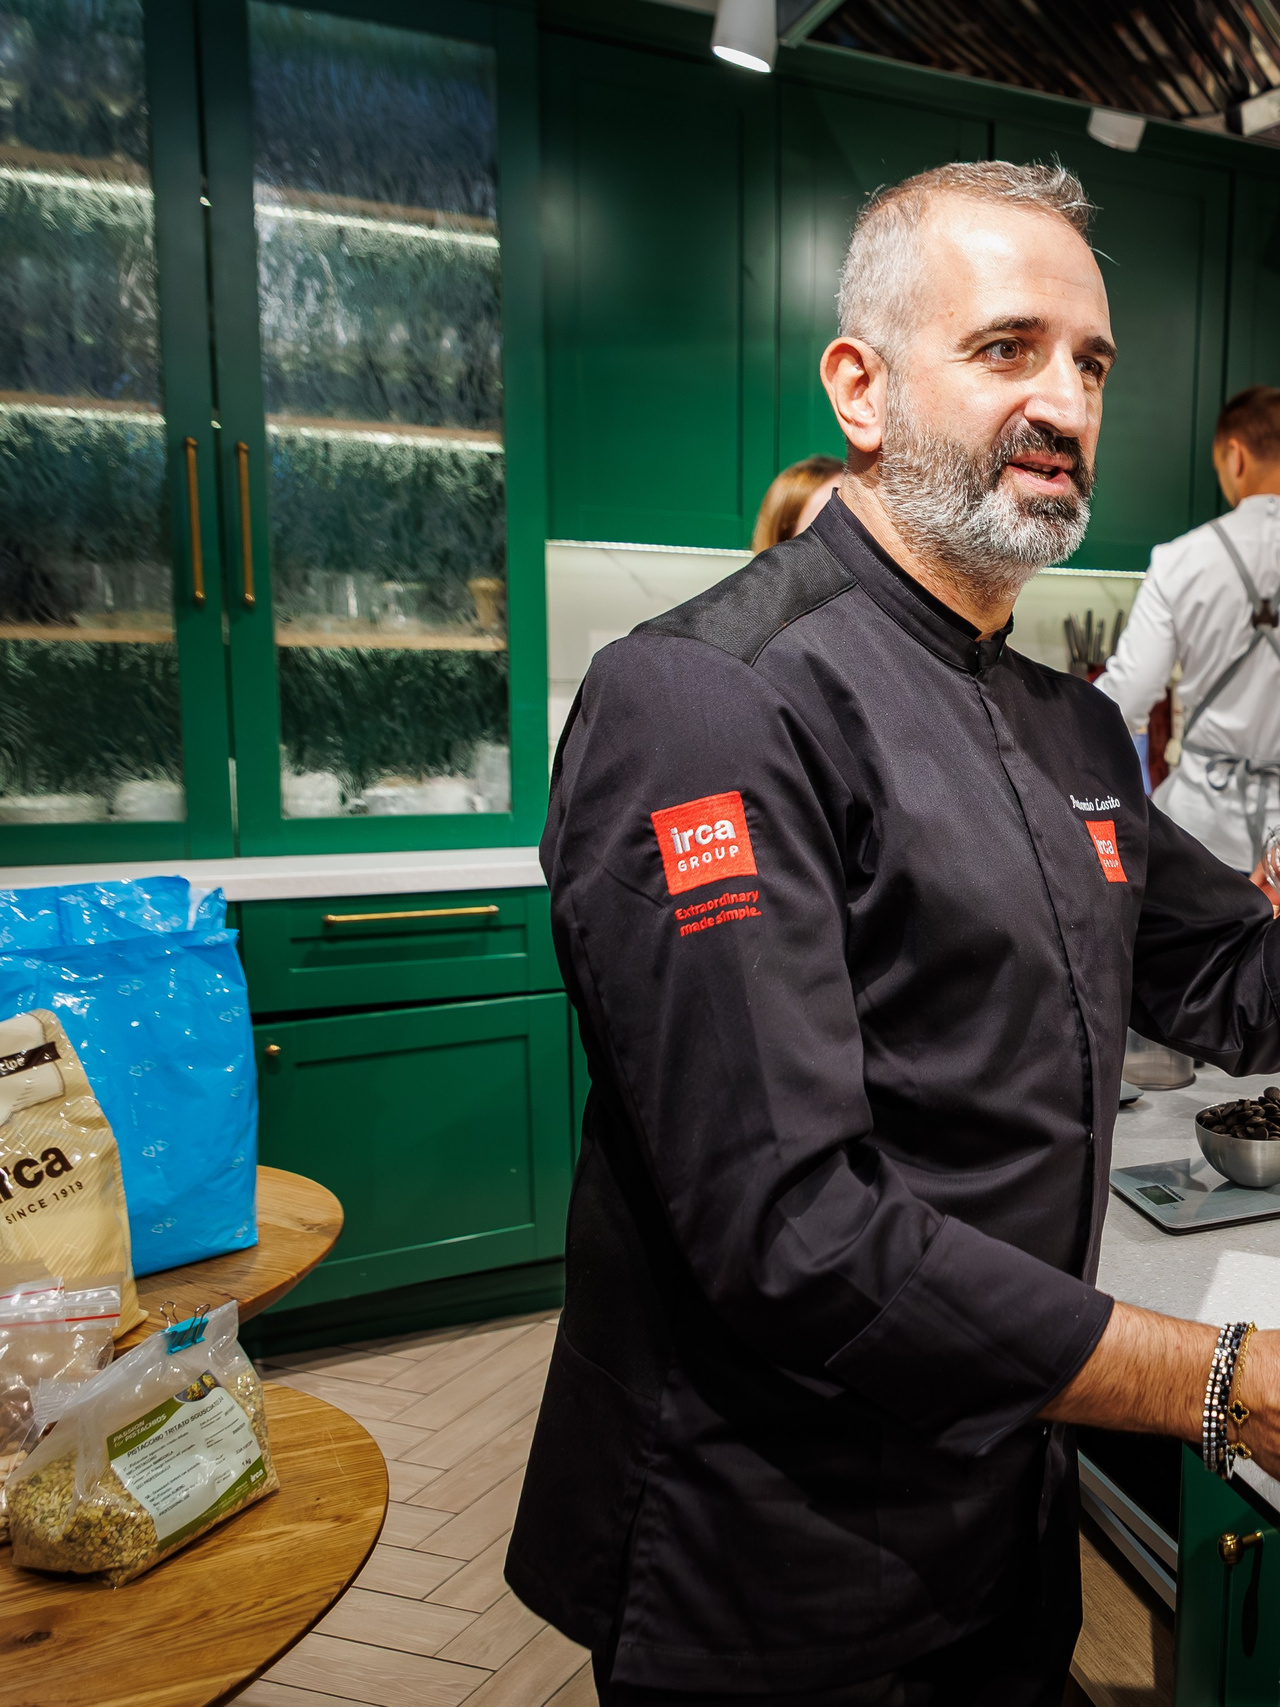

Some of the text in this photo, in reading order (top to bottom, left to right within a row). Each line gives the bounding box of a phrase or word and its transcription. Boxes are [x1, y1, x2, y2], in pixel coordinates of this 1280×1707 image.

[670, 819, 737, 854] irca
[1093, 834, 1115, 855] irca
[677, 845, 740, 873] GROUP
[674, 890, 760, 921] Extraordinary
[680, 917, 715, 937] made
[0, 1147, 74, 1204] rca
[5, 1181, 84, 1225] SINCE 1919
[113, 1420, 145, 1443] PASSION
[127, 1434, 164, 1458] PISTACCHIO
